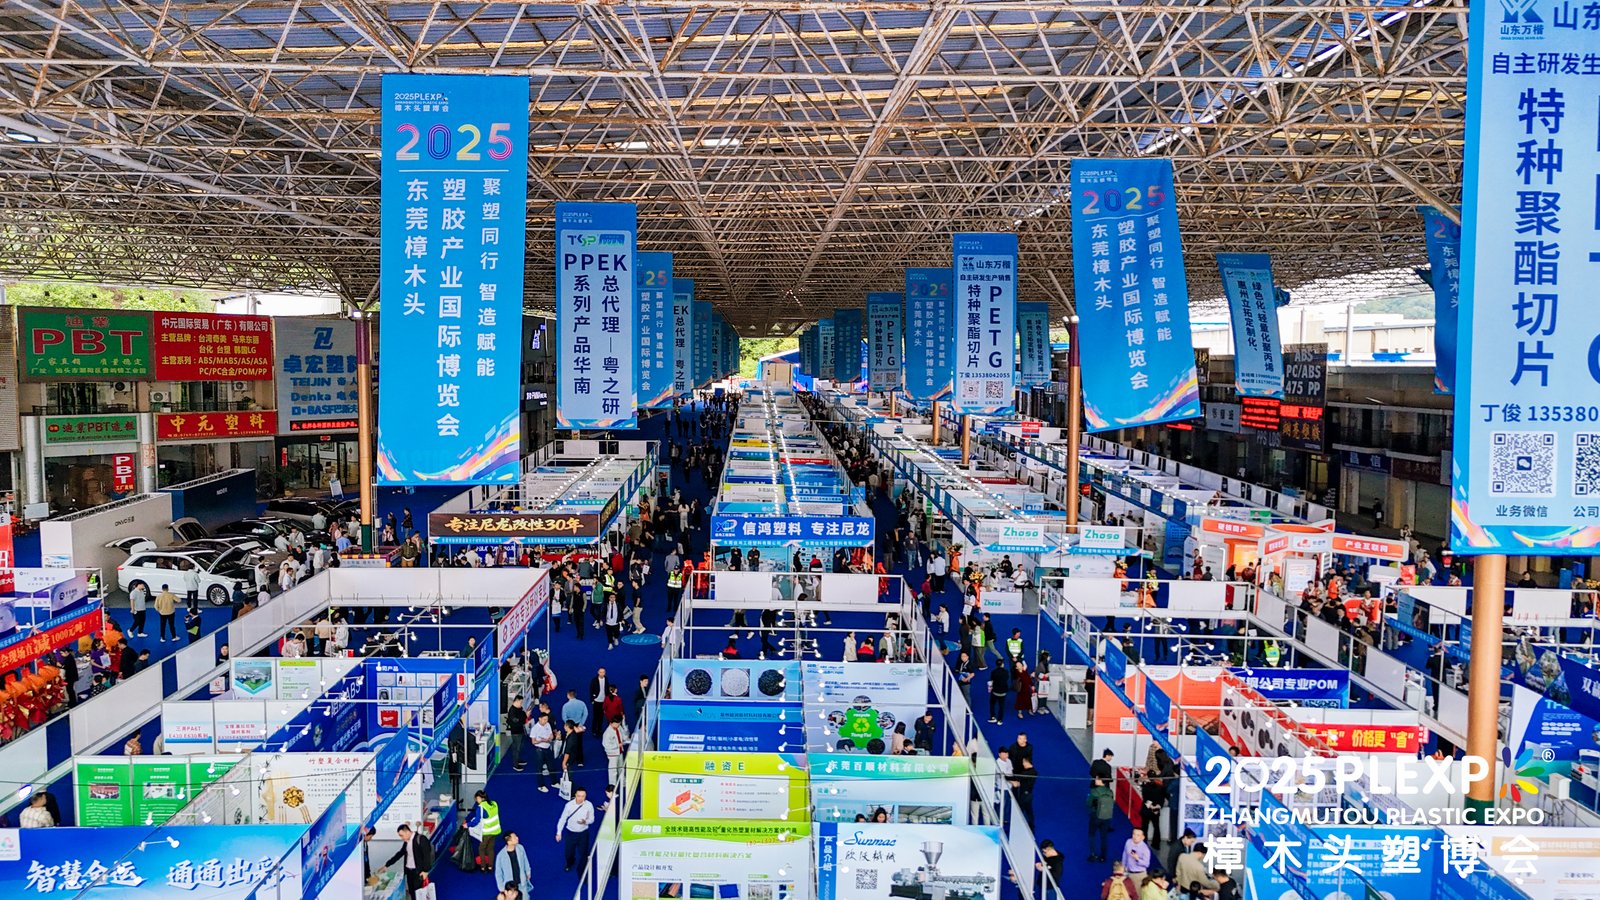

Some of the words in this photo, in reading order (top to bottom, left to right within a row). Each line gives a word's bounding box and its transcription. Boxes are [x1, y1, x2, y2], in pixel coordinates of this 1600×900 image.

[1493, 52, 1600, 75] 自主研发生
[396, 123, 513, 160] 2025
[1082, 186, 1166, 214] 2025
[480, 178, 501, 270] 聚塑同行
[1510, 88, 1566, 387] 特种聚酯切片
[402, 178, 428, 316] 东莞樟木头
[1146, 215, 1164, 270] 聚塑同行
[564, 254, 627, 271] PPEK
[1090, 224, 1112, 311] 东莞樟木头
[911, 283, 948, 296] 2025
[436, 178, 466, 438] 塑胶产业国际博览会
[1118, 221, 1148, 390] 塑胶产业国际博览会
[1152, 277, 1172, 342] 智造赋能
[476, 282, 497, 377] 智造赋能
[572, 274, 591, 395] 系列产品华南
[913, 302, 922, 346] 东莞樟木头
[967, 284, 981, 368] 特种聚酯切片
[989, 286, 1002, 368] PETG
[32, 328, 143, 355] PBT
[199, 345, 214, 354] 台化
[641, 292, 651, 391] 塑胶产业国际博览会
[887, 321, 895, 366] PETG
[926, 301, 934, 386] 塑胶产业国际博览会
[1295, 349, 1313, 362] ABS
[198, 357, 268, 365] ABS/MABS/AS/ASA
[199, 367, 267, 376] PC/PC合金/POM/PP
[1286, 365, 1321, 378] PC/ABS
[290, 378, 331, 386] TEIJIN
[1308, 382, 1320, 395] PP
[290, 392, 331, 401] Denka
[170, 415, 265, 433] 中元塑料
[1480, 403, 1521, 422] 丁俊
[116, 456, 132, 484] PBT
[1496, 505, 1548, 518] 业务微信
[1573, 506, 1600, 518] 公司
[445, 517, 584, 535] 专注尼龙改性30年
[742, 522, 802, 536] 信鸿塑料
[811, 522, 870, 536] 专注尼龙
[165, 855, 288, 890] 通通出彩
